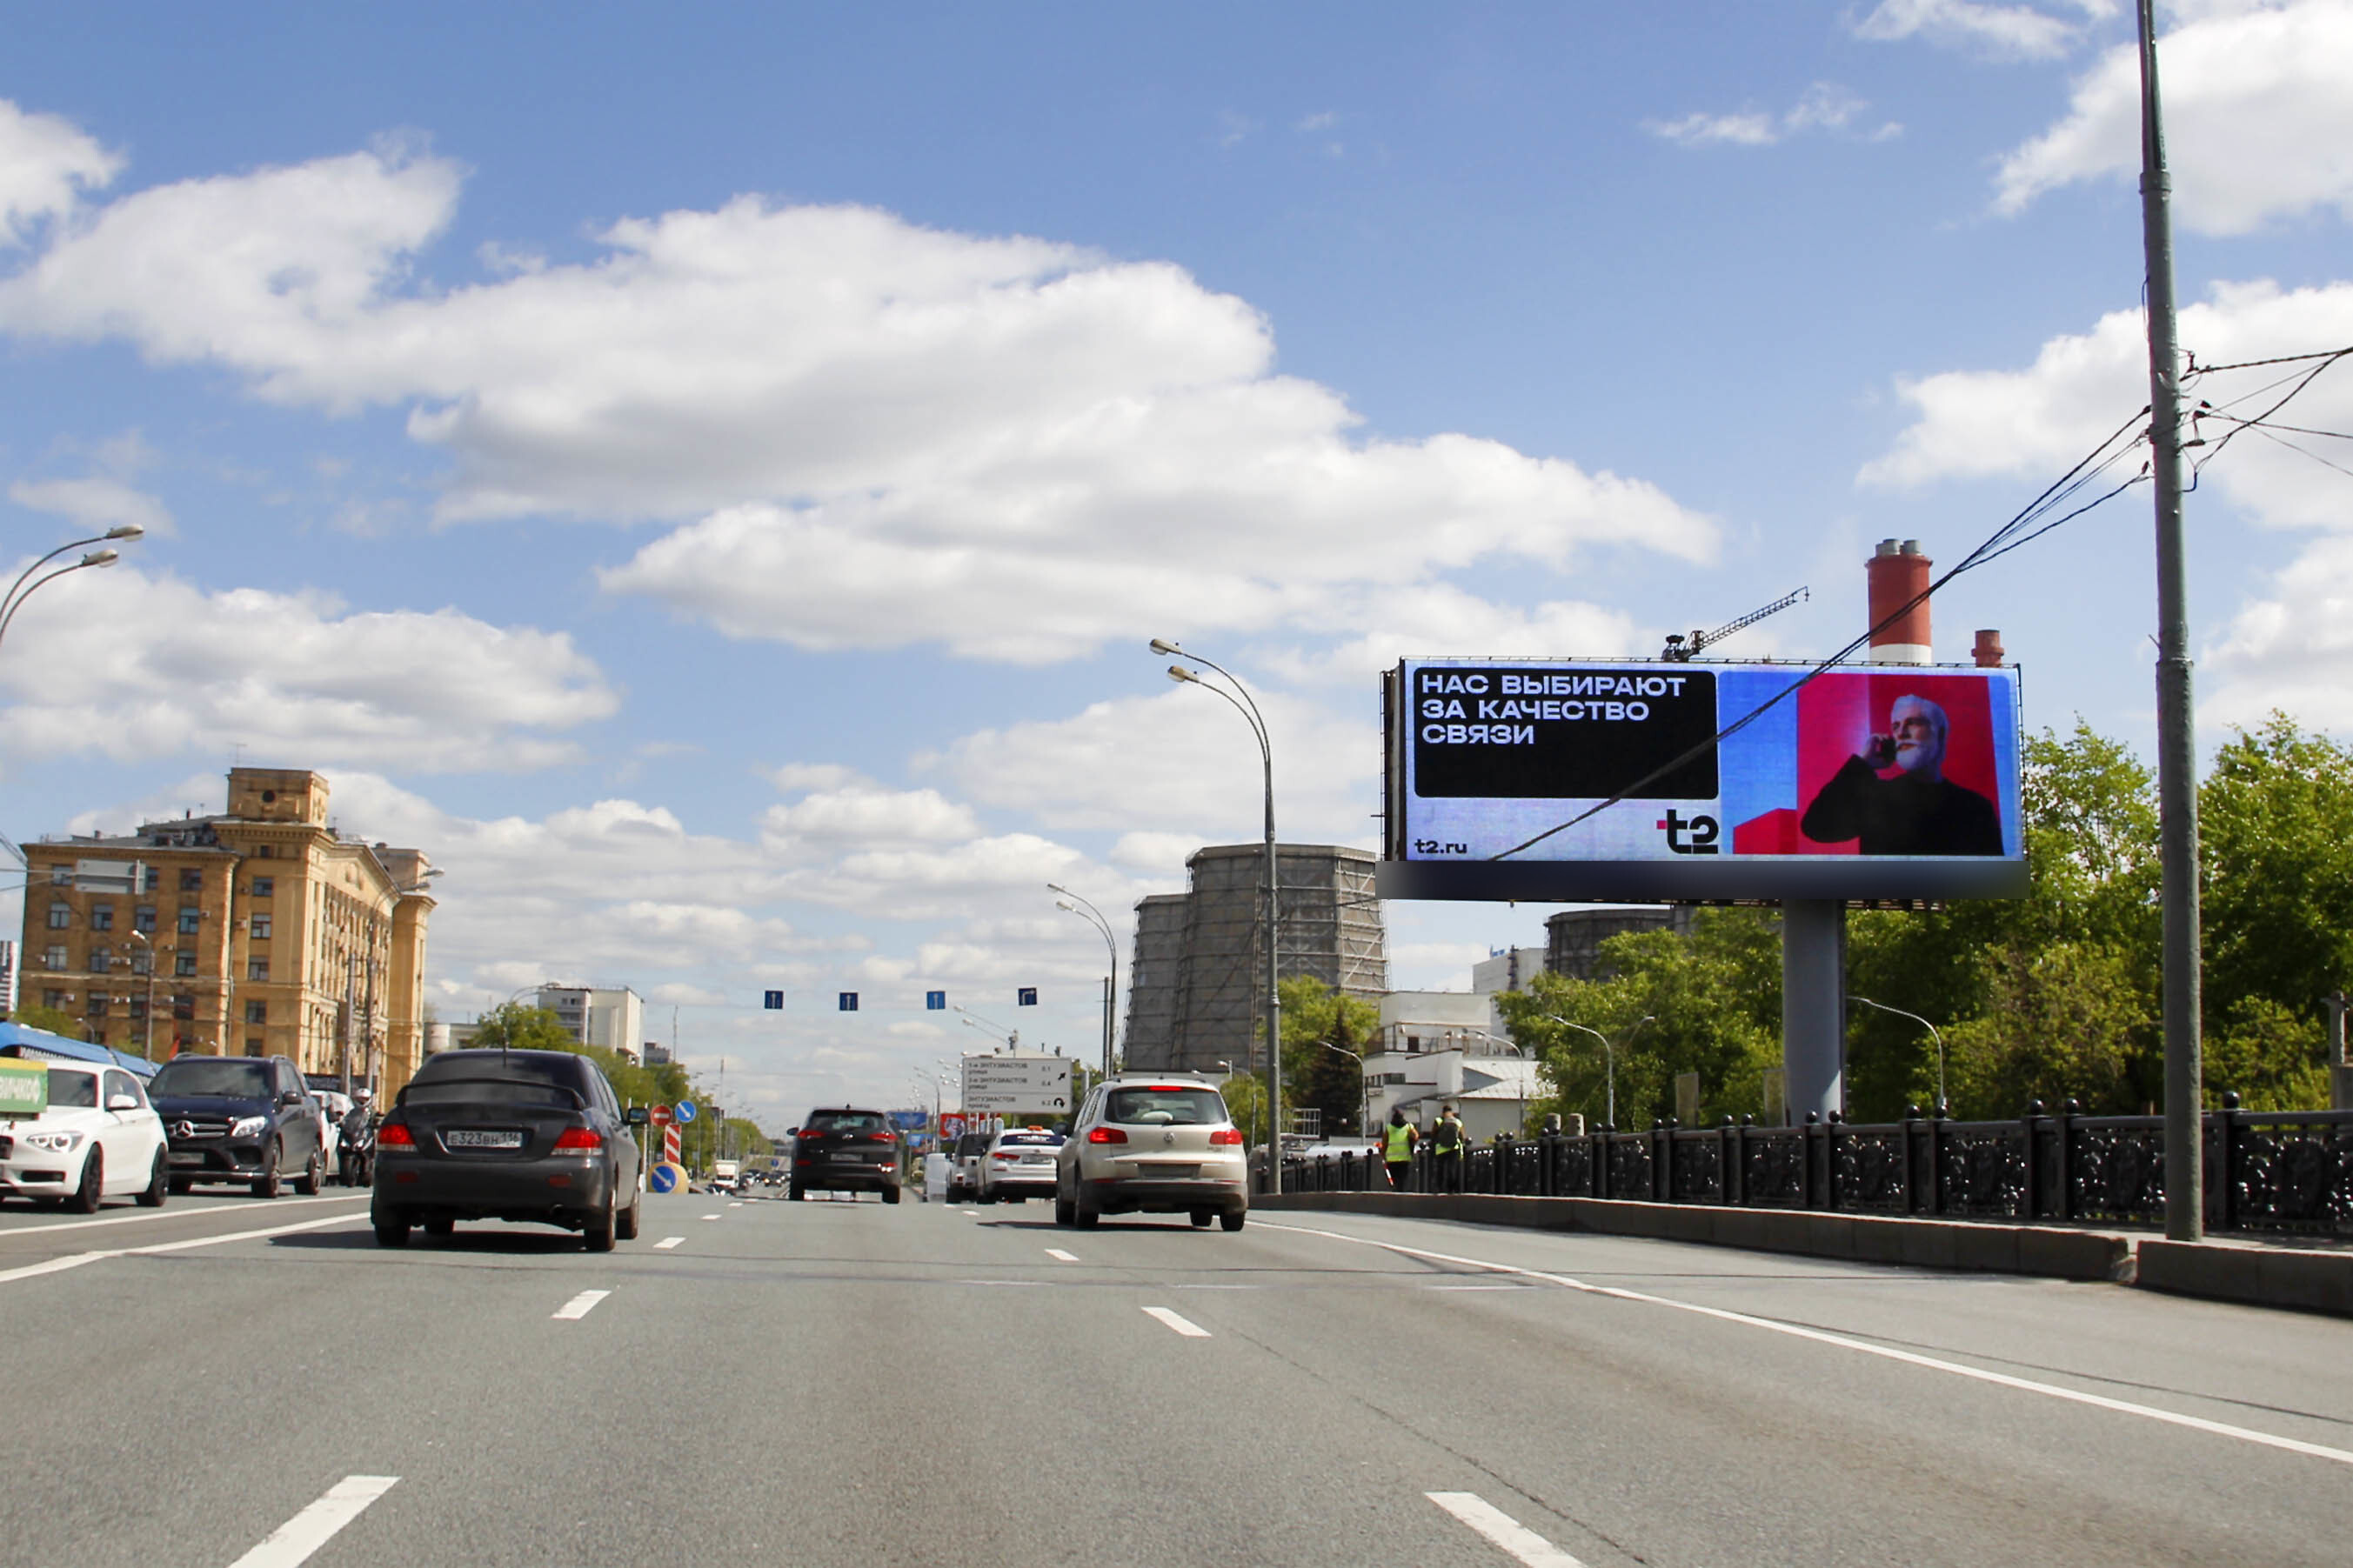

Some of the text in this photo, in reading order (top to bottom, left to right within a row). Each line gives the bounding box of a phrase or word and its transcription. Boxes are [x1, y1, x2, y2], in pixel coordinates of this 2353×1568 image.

[1422, 675, 1687, 696] НАС ВЫБИРАЮТ
[1422, 699, 1649, 721] ЗА КАЧЕСТВО
[1422, 724, 1534, 744] СВЯЗИ
[1656, 809, 1719, 854] t2
[1414, 838, 1467, 854] t2.ru
